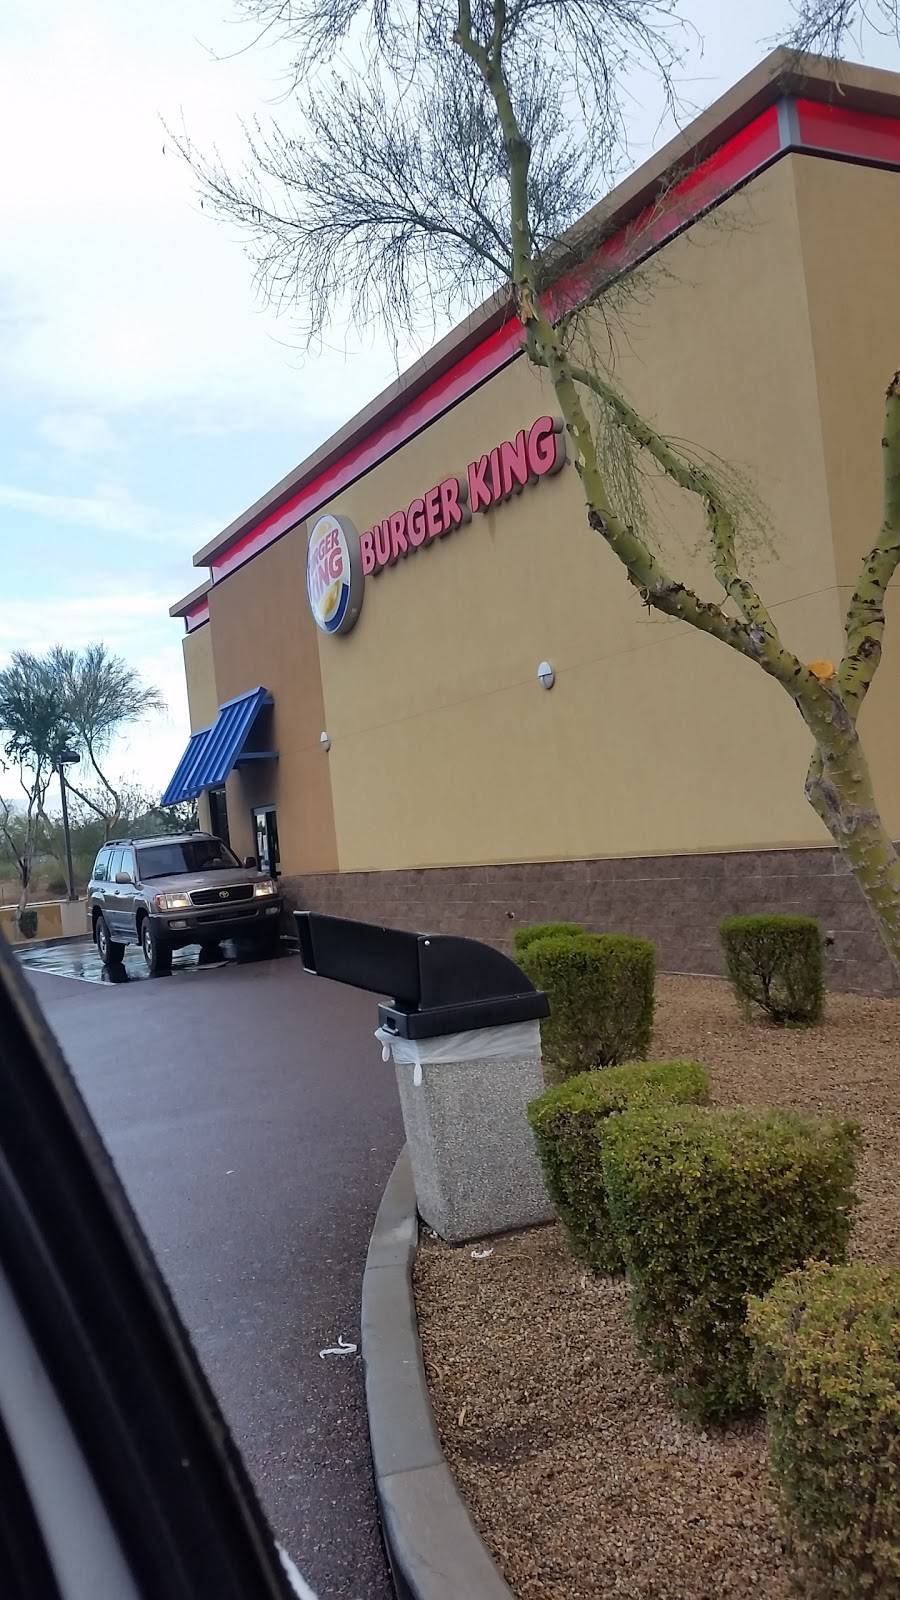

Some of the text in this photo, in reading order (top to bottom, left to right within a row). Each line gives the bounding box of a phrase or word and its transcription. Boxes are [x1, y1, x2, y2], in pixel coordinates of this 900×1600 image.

[359, 416, 557, 576] BURGER KING
[307, 528, 340, 567] RGER
[310, 547, 343, 595] ING
